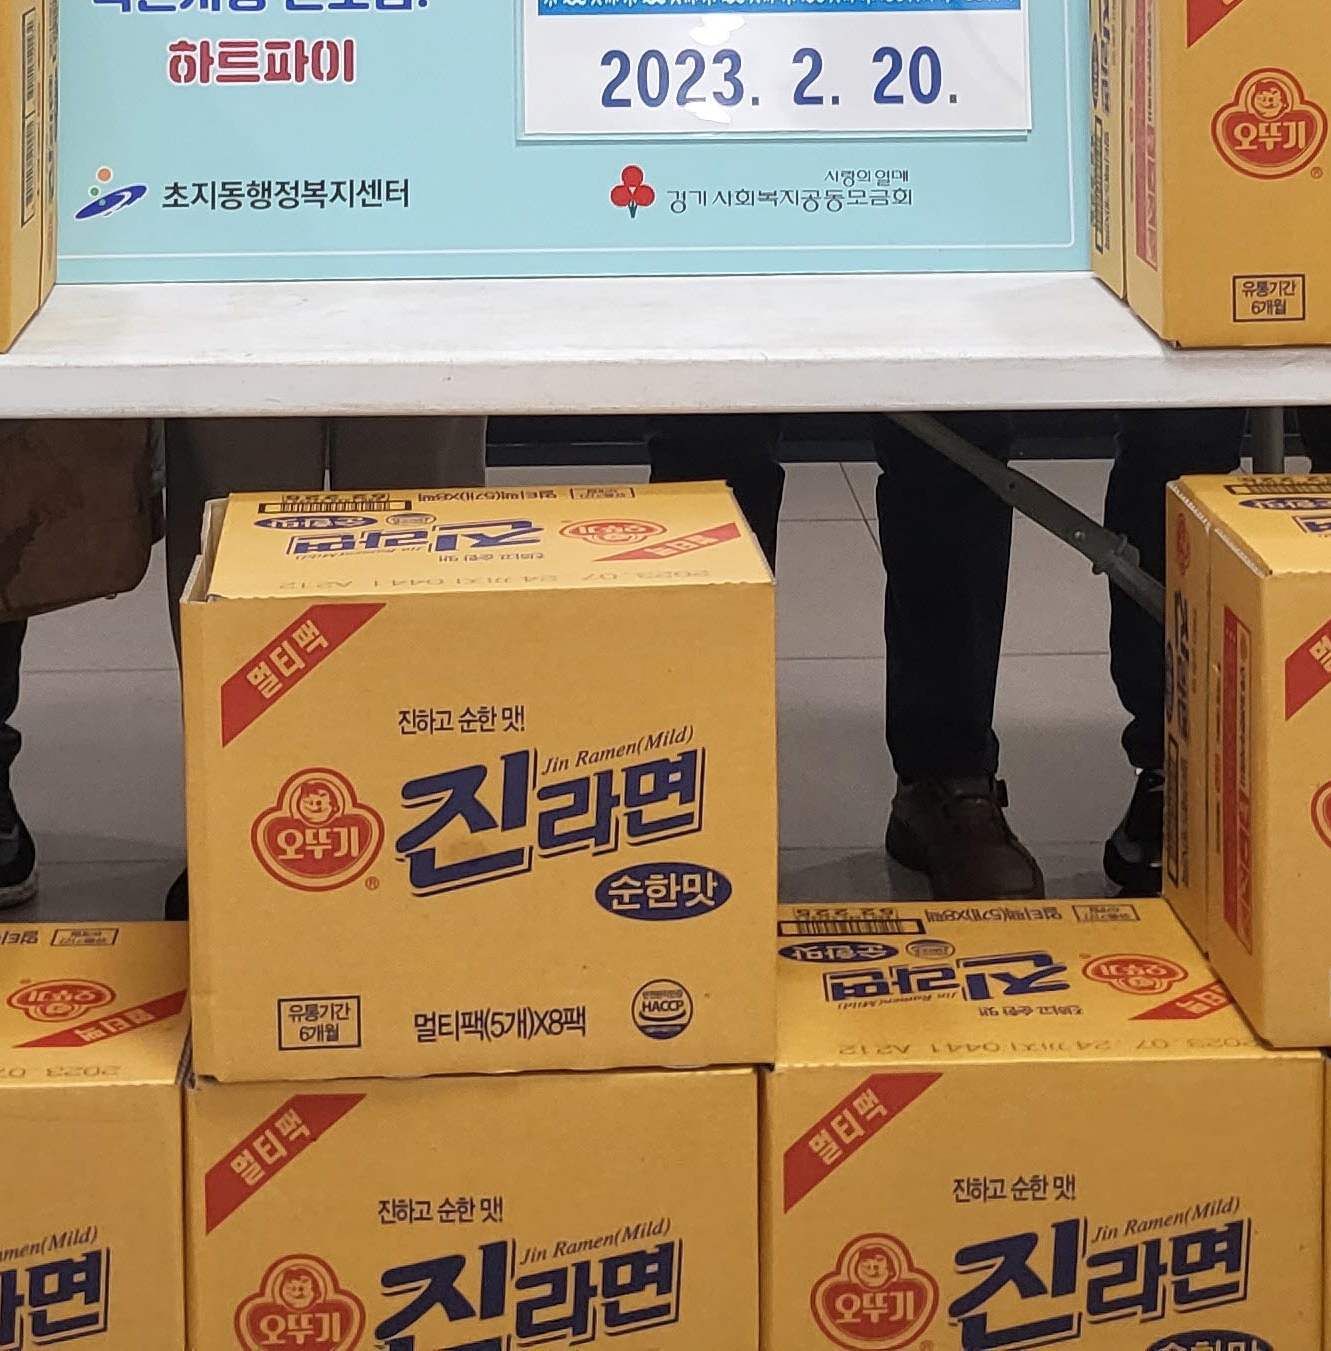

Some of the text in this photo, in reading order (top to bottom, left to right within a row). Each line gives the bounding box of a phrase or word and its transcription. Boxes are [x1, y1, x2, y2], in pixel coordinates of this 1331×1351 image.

[167, 37, 357, 86] 하트파이
[600, 46, 959, 110] 2023. 2. 20.
[1234, 122, 1306, 150] 오뚜기
[163, 179, 408, 210] 초지동행정복지센터
[1241, 281, 1296, 298] 유통기간
[1251, 299, 1286, 316] 6개월
[286, 519, 544, 556] 진라면
[246, 619, 328, 699] 멀티팩
[399, 709, 454, 735] 진하고
[458, 706, 497, 733] 순한
[541, 725, 694, 775] Jin Ramen(Mild)
[395, 746, 705, 898] 진라면
[276, 830, 359, 860] 오뚜기
[607, 873, 718, 909] 순한맛
[792, 944, 887, 960] 순한맛
[823, 950, 1070, 1002] 진라면
[1101, 963, 1167, 978] 오뚜기
[288, 1003, 350, 1022] 유통기간
[642, 1000, 684, 1012] HACCP
[299, 1023, 339, 1042] 6개월
[808, 1088, 889, 1167] 멀티팩
[229, 1108, 312, 1187] 멀티팩
[953, 1177, 1007, 1203] 진하고
[1011, 1175, 1049, 1201] 순한
[378, 1199, 433, 1224] 진하고
[437, 1197, 475, 1223] 순한
[1091, 1195, 1241, 1243] Jin Ramen(Mild)
[520, 1216, 672, 1265] Jin Ramen(Mild)
[835, 1290, 915, 1324] 오뚜기
[260, 1312, 341, 1344] 오뚜기
